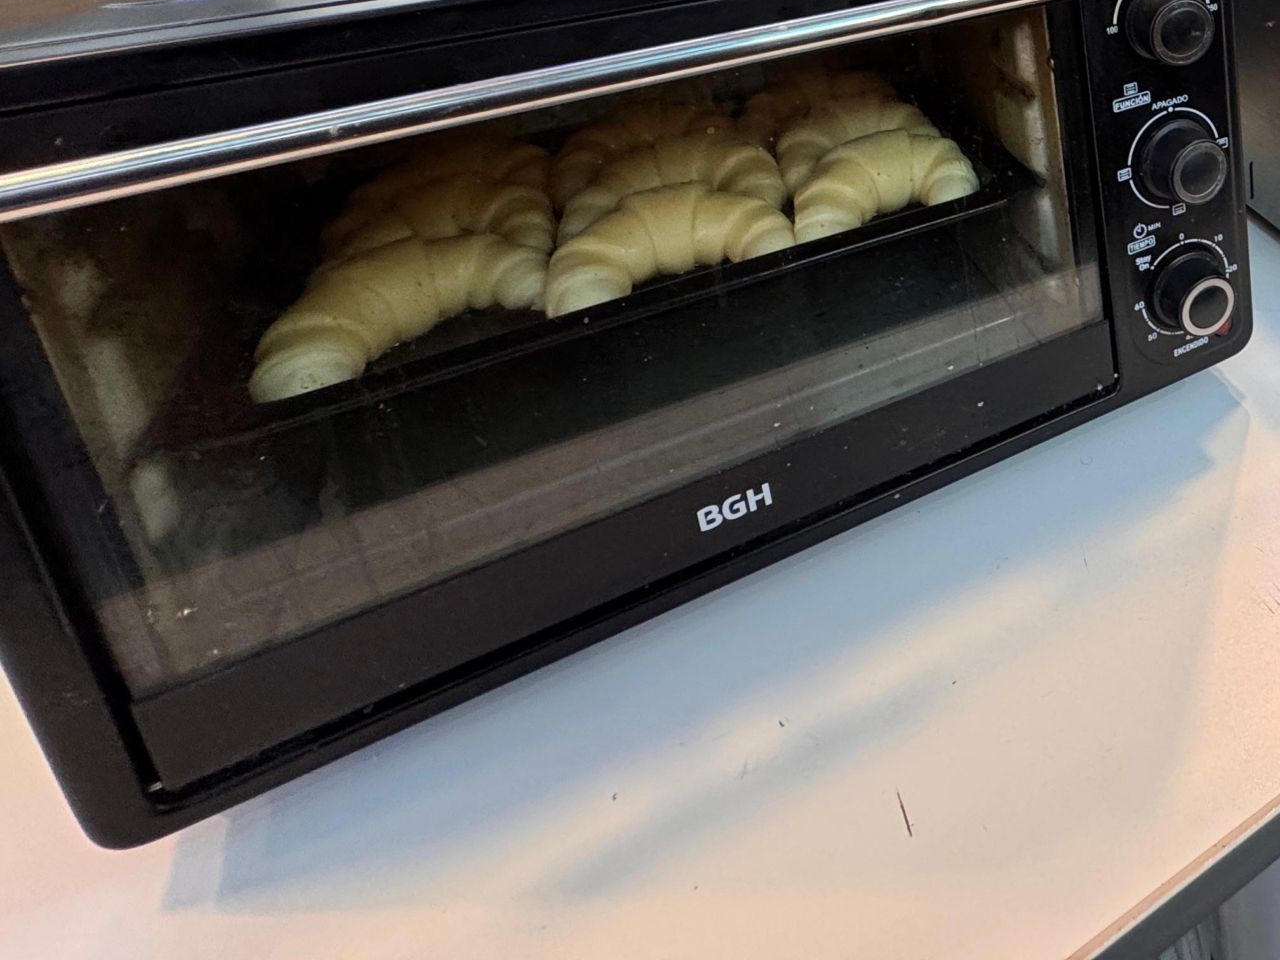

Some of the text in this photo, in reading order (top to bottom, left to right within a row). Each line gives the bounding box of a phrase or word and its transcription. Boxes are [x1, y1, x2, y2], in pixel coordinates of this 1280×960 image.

[1106, 26, 1119, 35] 100
[1115, 94, 1149, 111] FUNCIÓN
[1151, 94, 1189, 111] APAGADO
[1147, 222, 1161, 231] MIN
[1214, 234, 1223, 242] 10
[1129, 238, 1155, 253] TIEMPO
[1135, 255, 1152, 265] Stay
[1139, 263, 1150, 271] On
[1134, 301, 1145, 311] 60
[1148, 332, 1158, 341] 50
[1173, 336, 1209, 357] ENCENDIDO
[696, 482, 773, 532] BGH
